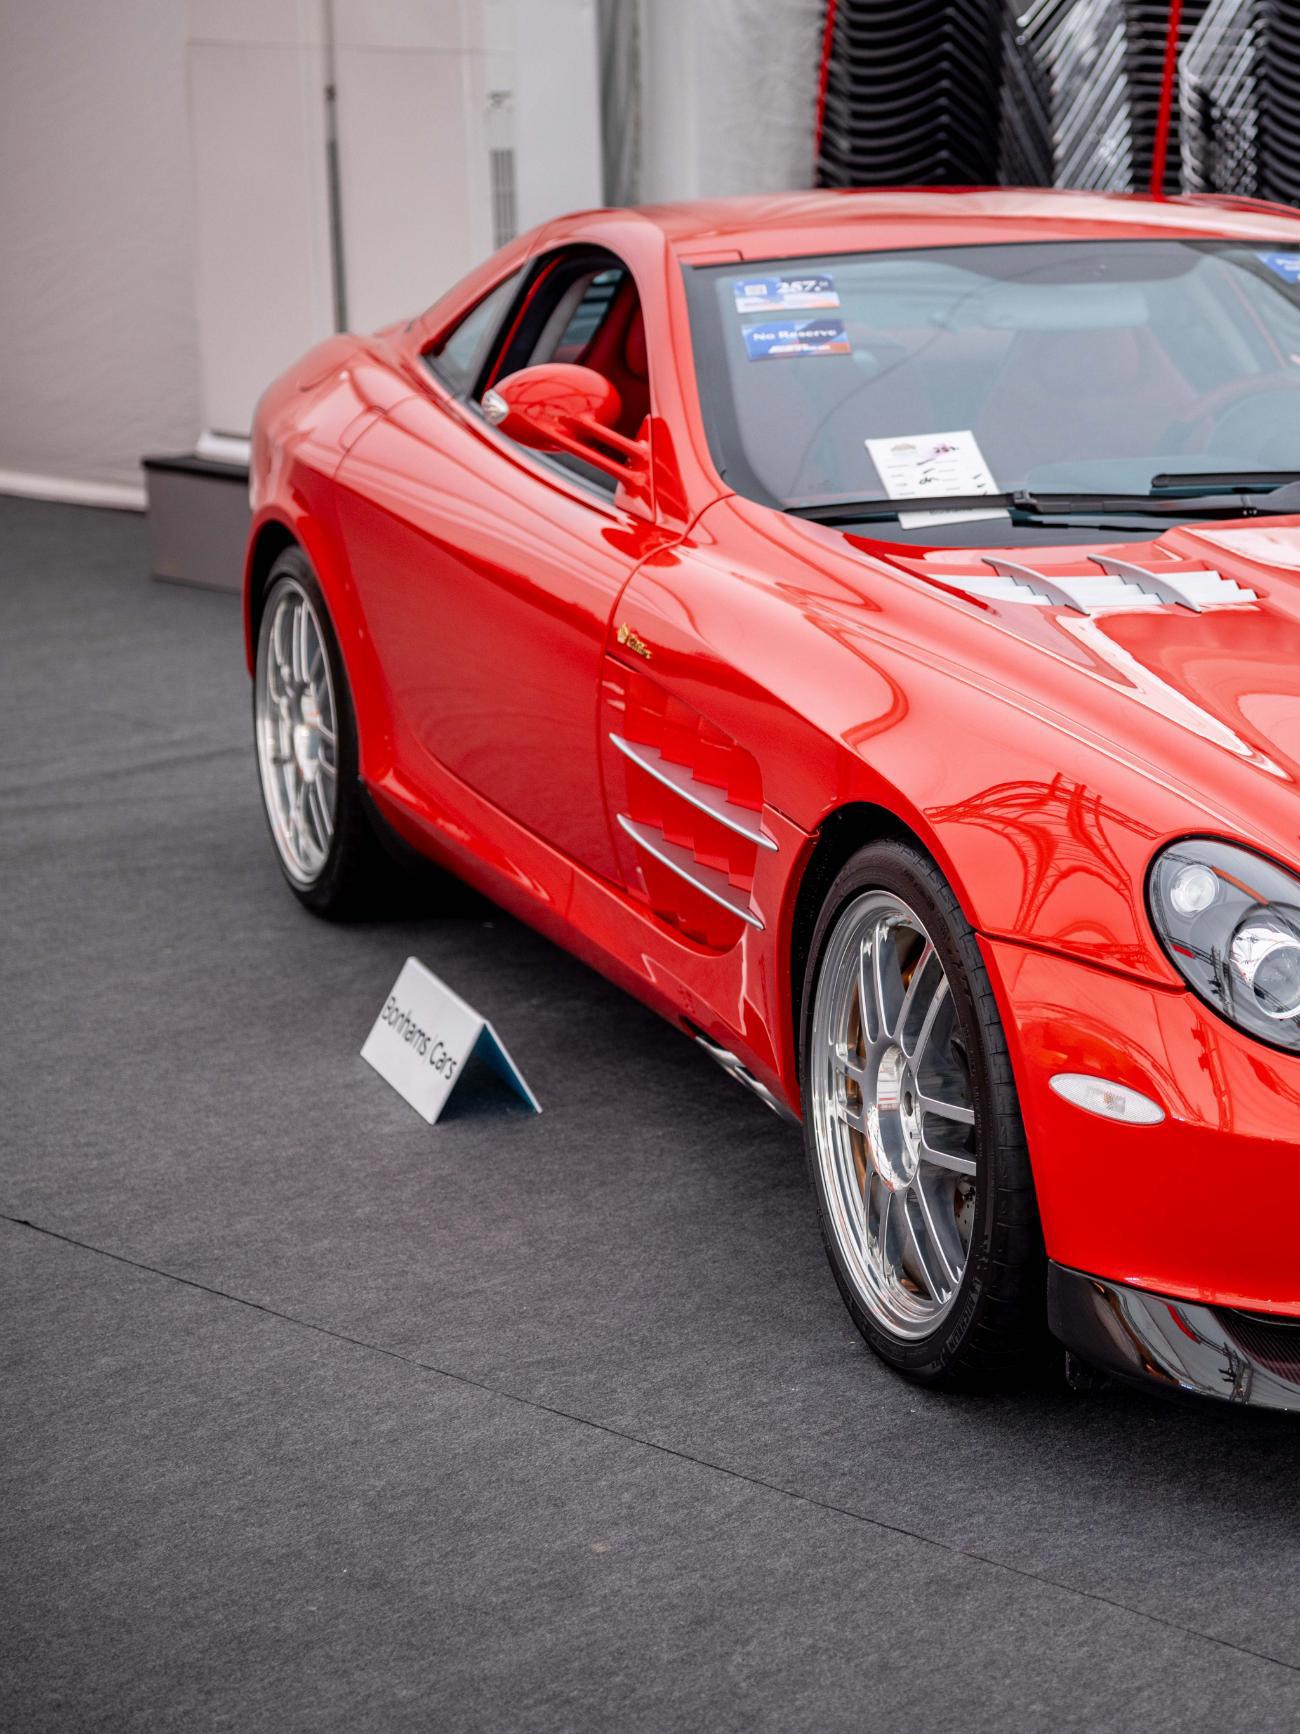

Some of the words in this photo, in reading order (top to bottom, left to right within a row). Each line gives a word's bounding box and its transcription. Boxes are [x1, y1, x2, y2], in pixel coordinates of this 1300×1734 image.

[778, 329, 837, 340] Reserve
[382, 996, 431, 1056] Bonhams
[429, 1041, 457, 1080] Cars
